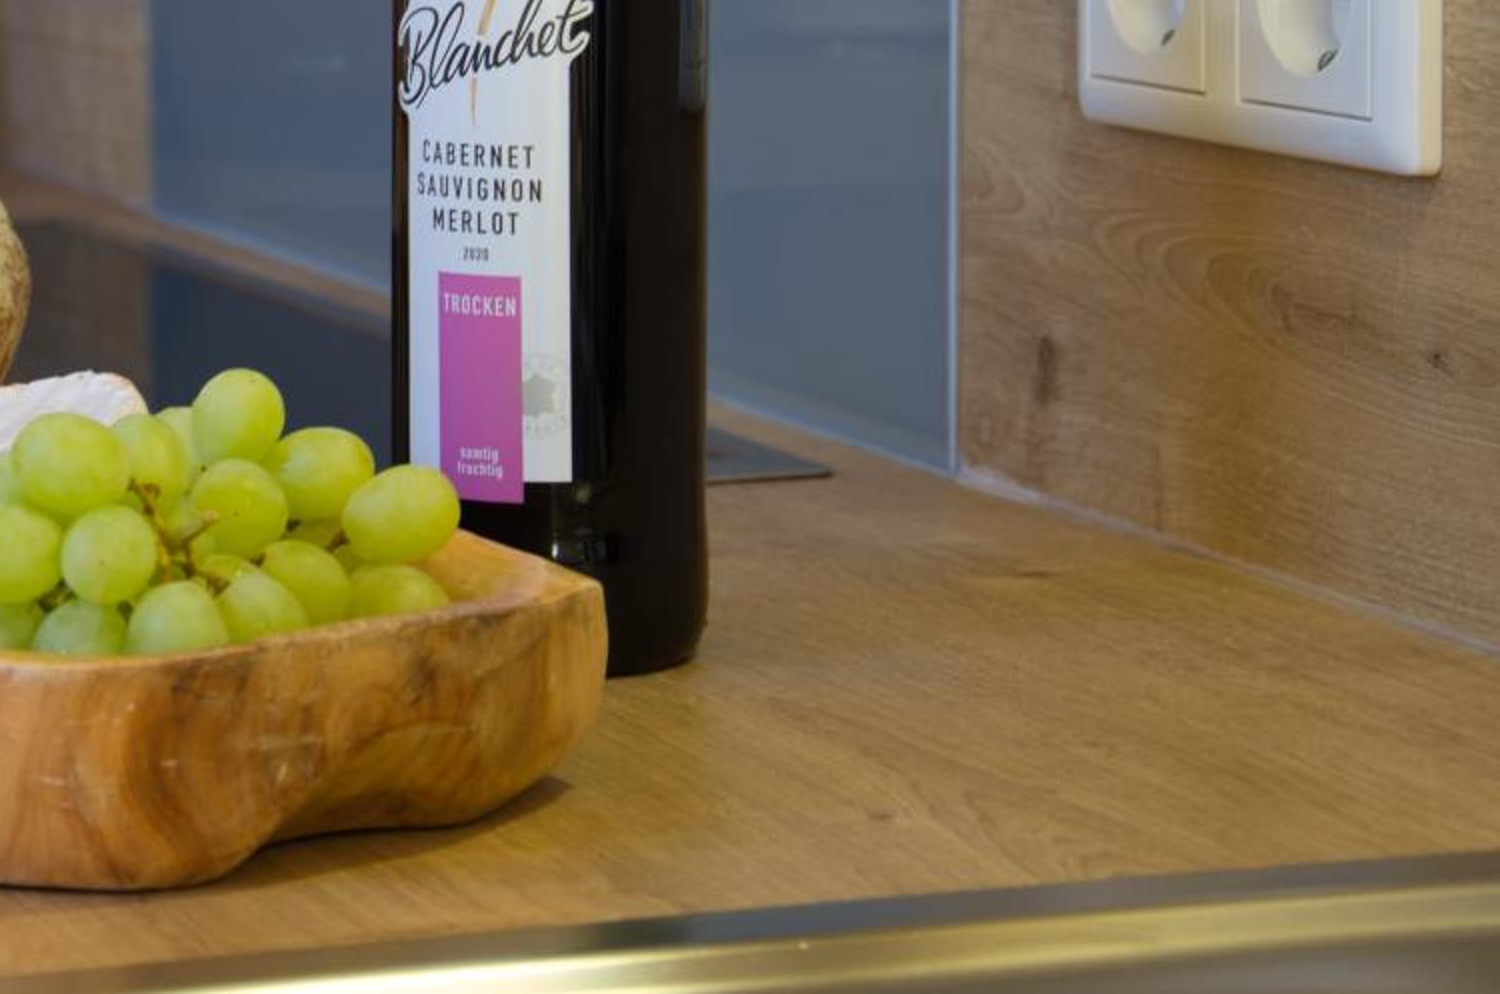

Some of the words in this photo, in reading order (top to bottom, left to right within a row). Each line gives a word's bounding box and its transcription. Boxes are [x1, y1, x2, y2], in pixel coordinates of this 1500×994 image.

[422, 138, 535, 169] CABERNET
[417, 171, 542, 204] SAUVIGNON
[432, 209, 520, 236] MERLOT
[443, 292, 516, 318] TROCKEN
